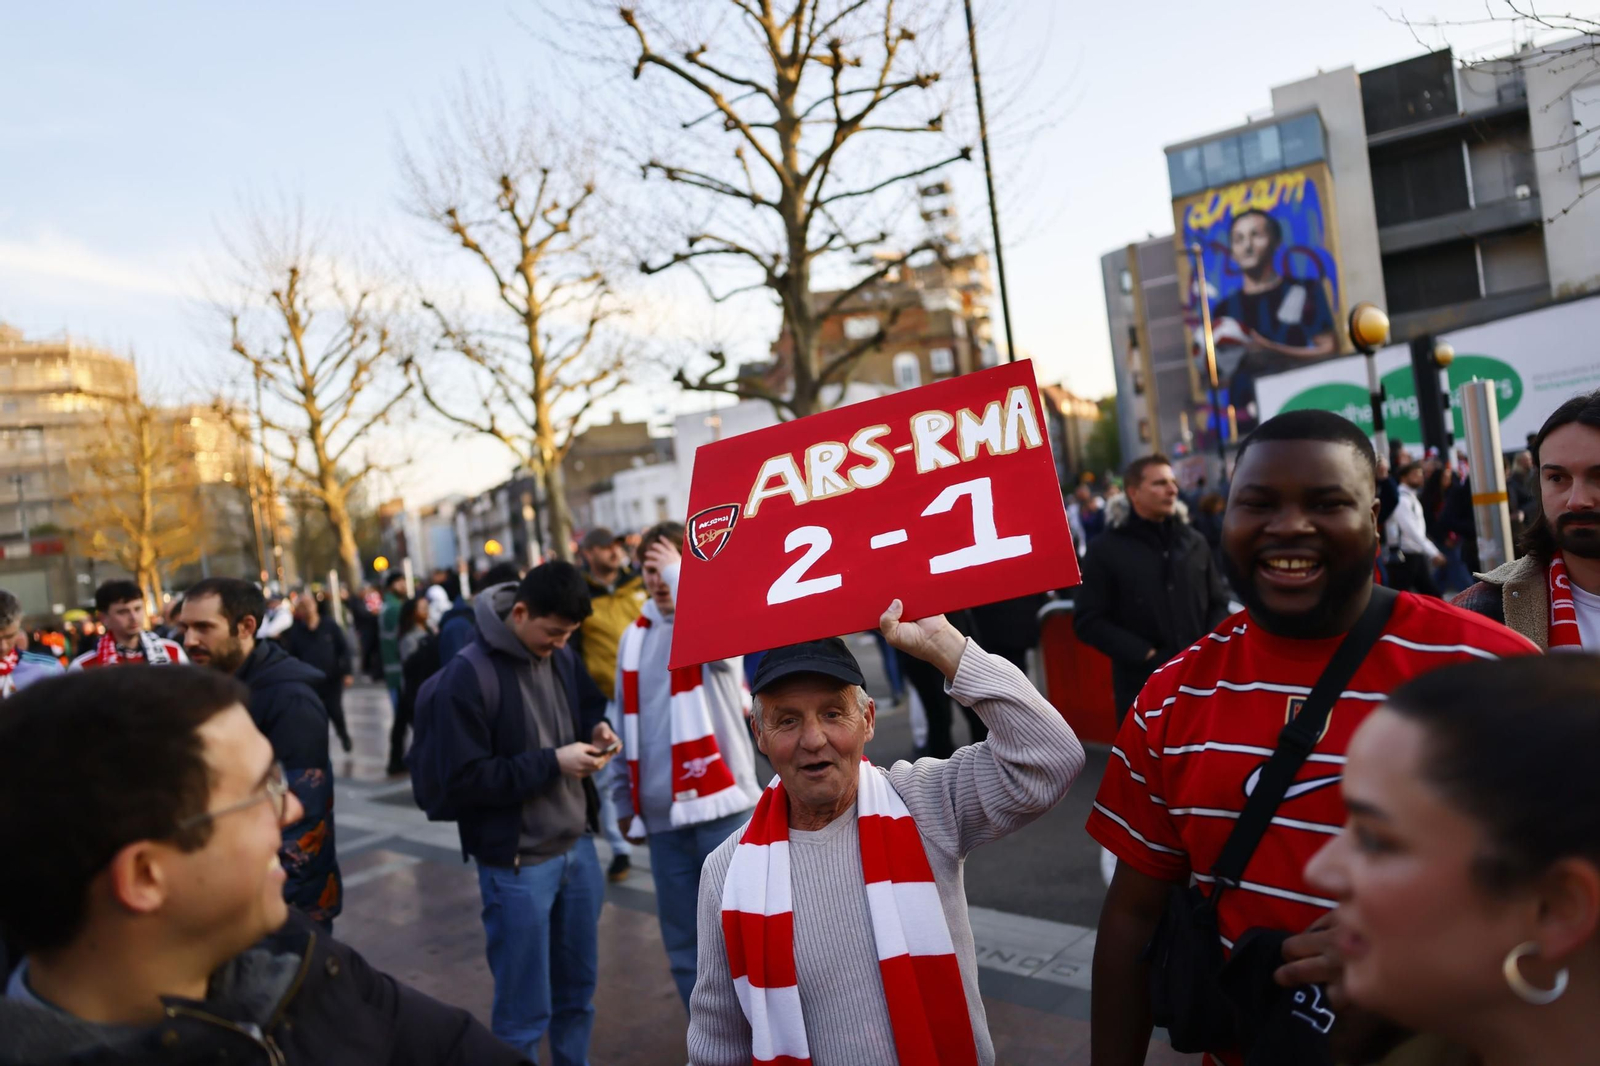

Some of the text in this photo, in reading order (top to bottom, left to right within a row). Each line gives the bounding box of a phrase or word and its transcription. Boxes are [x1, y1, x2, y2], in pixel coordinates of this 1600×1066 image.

[744, 385, 1043, 518] ARS-RMA
[767, 526, 842, 605] 2
[920, 477, 1032, 574] 1
